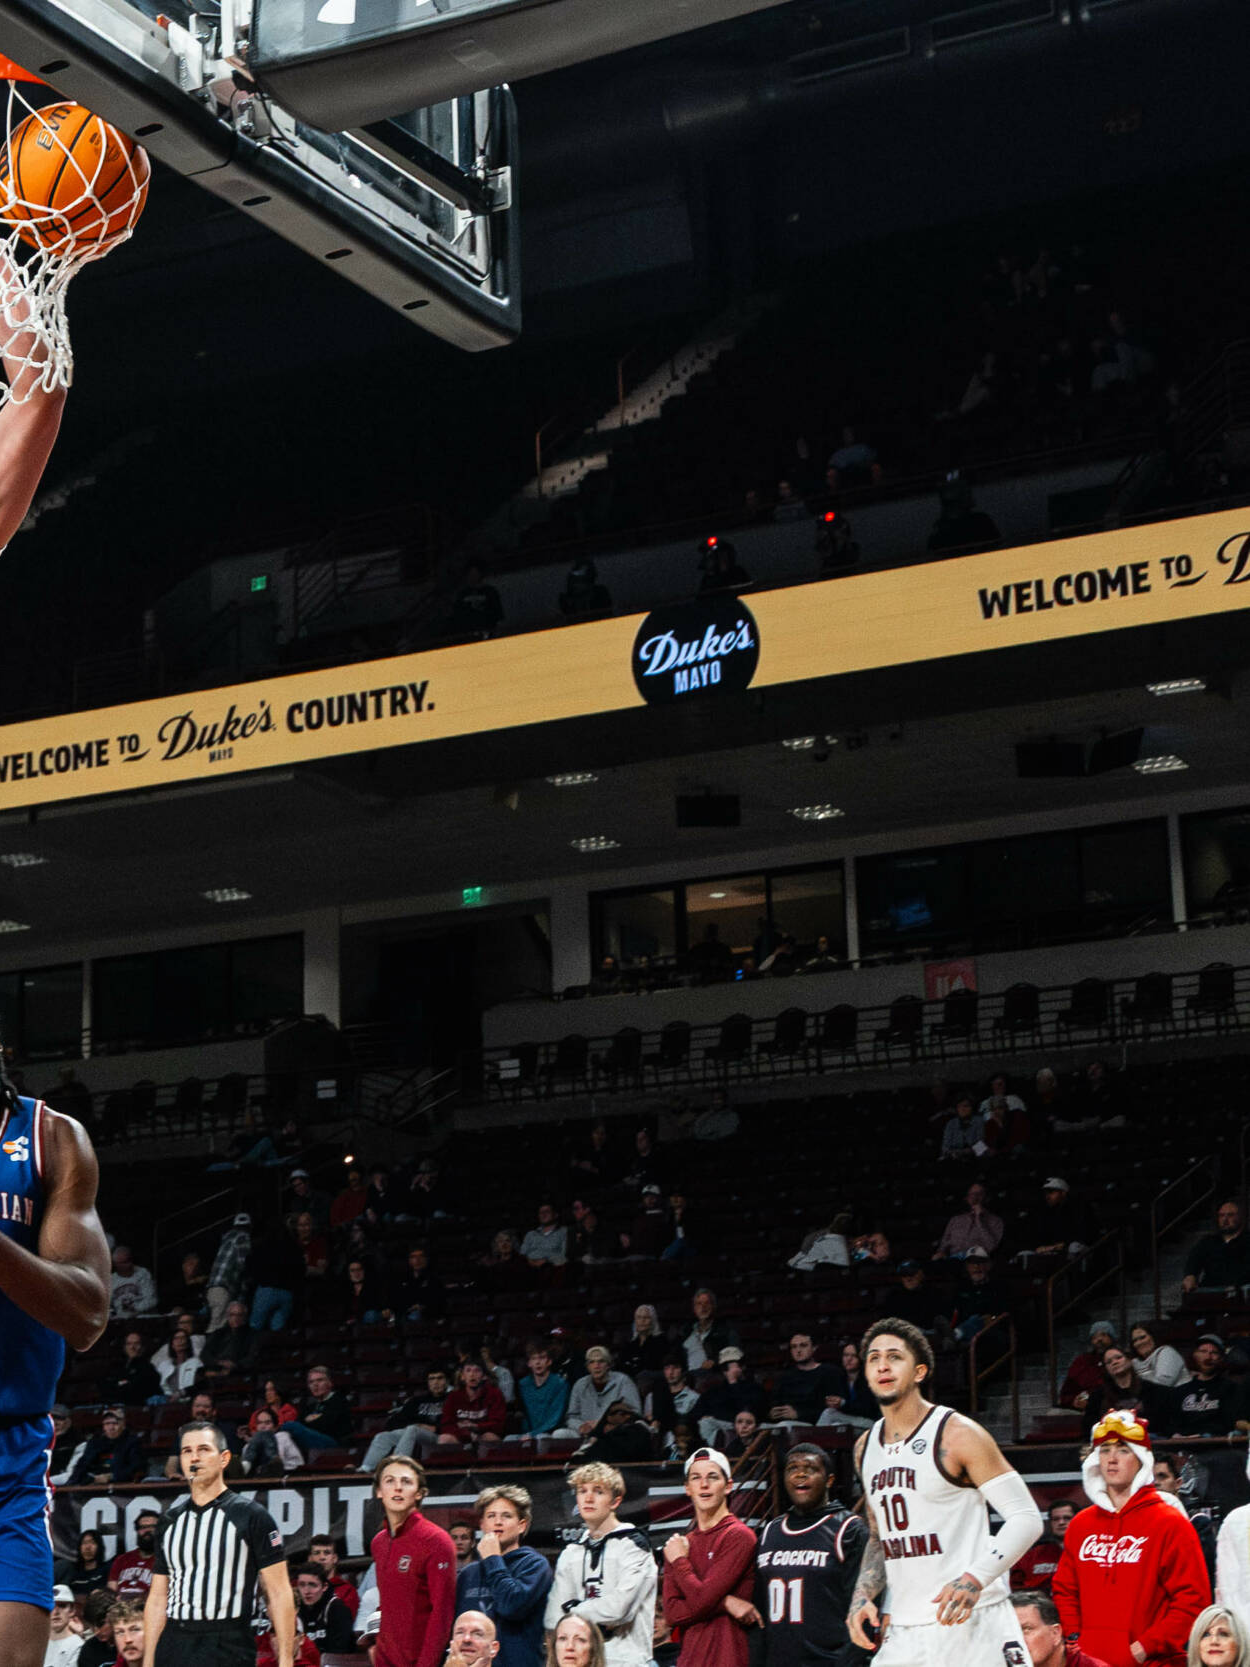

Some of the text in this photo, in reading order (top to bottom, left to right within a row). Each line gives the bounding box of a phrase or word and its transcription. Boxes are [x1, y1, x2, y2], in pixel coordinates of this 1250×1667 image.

[978, 560, 1152, 620] WELCOME
[1159, 554, 1202, 585] TO
[639, 619, 754, 676] Duke's
[674, 660, 721, 694] MAYO
[118, 733, 146, 760] TO
[157, 700, 276, 763] Duke's
[286, 680, 436, 734] COUNTRY.
[871, 1466, 917, 1495] SOUTH
[879, 1493, 910, 1532] 10
[771, 1549, 831, 1568] COCKPIT
[768, 1576, 806, 1624] 01
